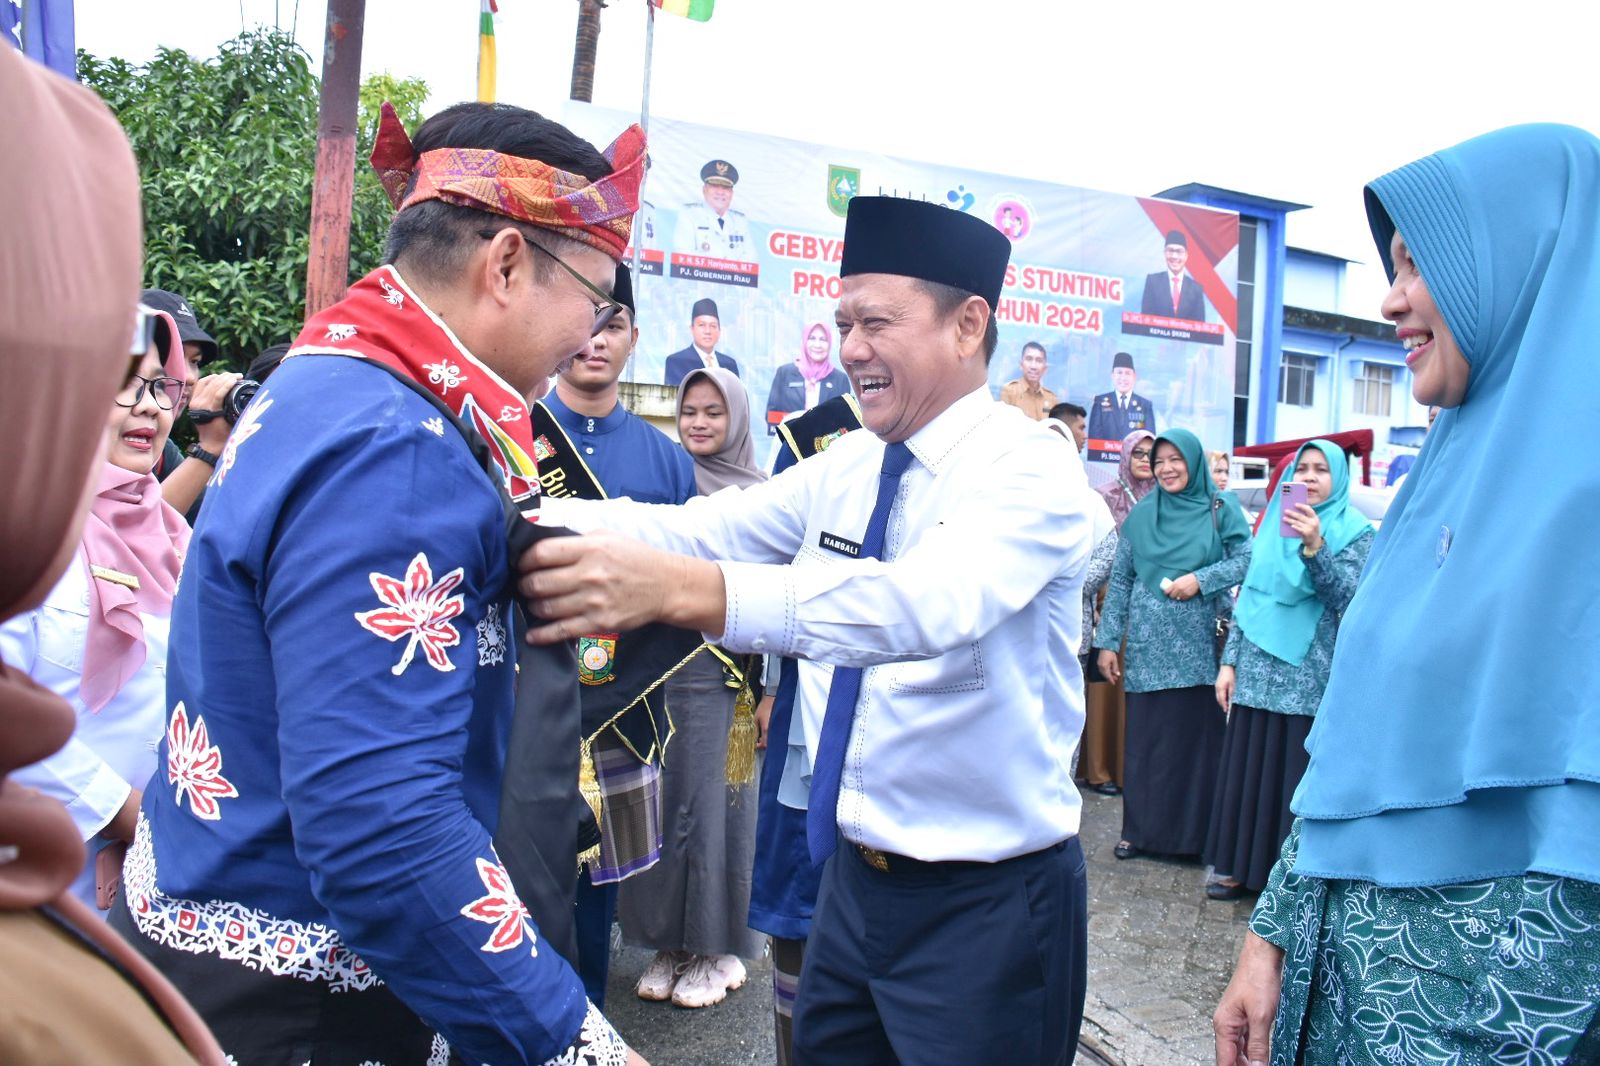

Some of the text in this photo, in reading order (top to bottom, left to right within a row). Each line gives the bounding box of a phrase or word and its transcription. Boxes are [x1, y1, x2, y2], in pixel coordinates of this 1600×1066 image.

[680, 267, 751, 284] PJ. GUBERNUR RIAU
[769, 232, 1121, 301] GEBYA S STUNTING
[793, 271, 843, 299] PRO
[997, 298, 1040, 324] HUN
[1045, 304, 1100, 332] 2024
[1149, 328, 1170, 337] KEPALA
